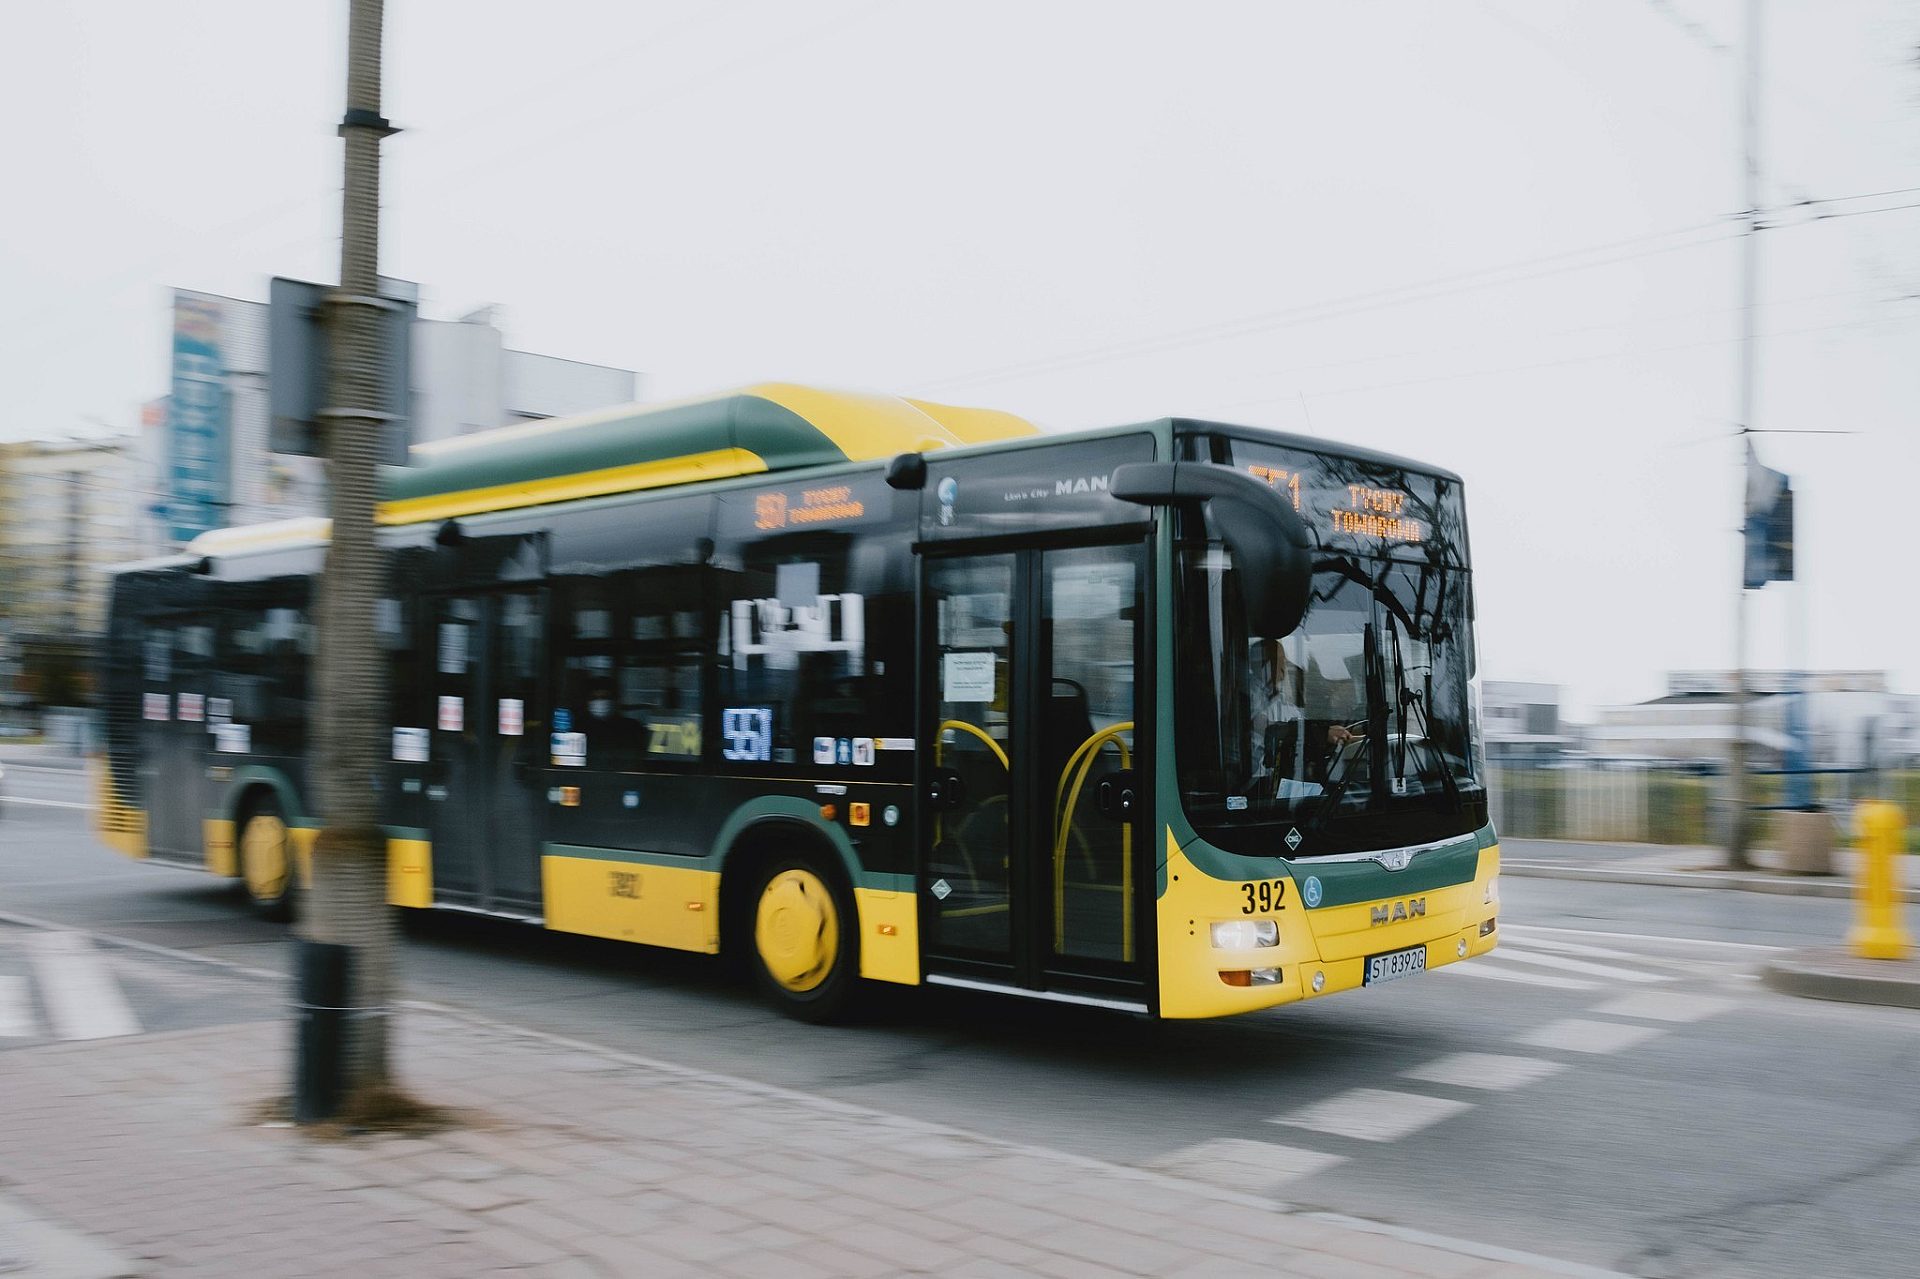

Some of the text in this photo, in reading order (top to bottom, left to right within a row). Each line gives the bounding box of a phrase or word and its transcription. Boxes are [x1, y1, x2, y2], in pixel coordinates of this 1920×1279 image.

[1055, 475, 1108, 496] MAN
[1349, 485, 1404, 514] TYCHY
[1331, 509, 1421, 542] TOWAROWA
[1241, 880, 1286, 915] 392
[1370, 897, 1426, 928] MAN
[1372, 957, 1388, 979] ST
[1391, 949, 1424, 974] 8392G
